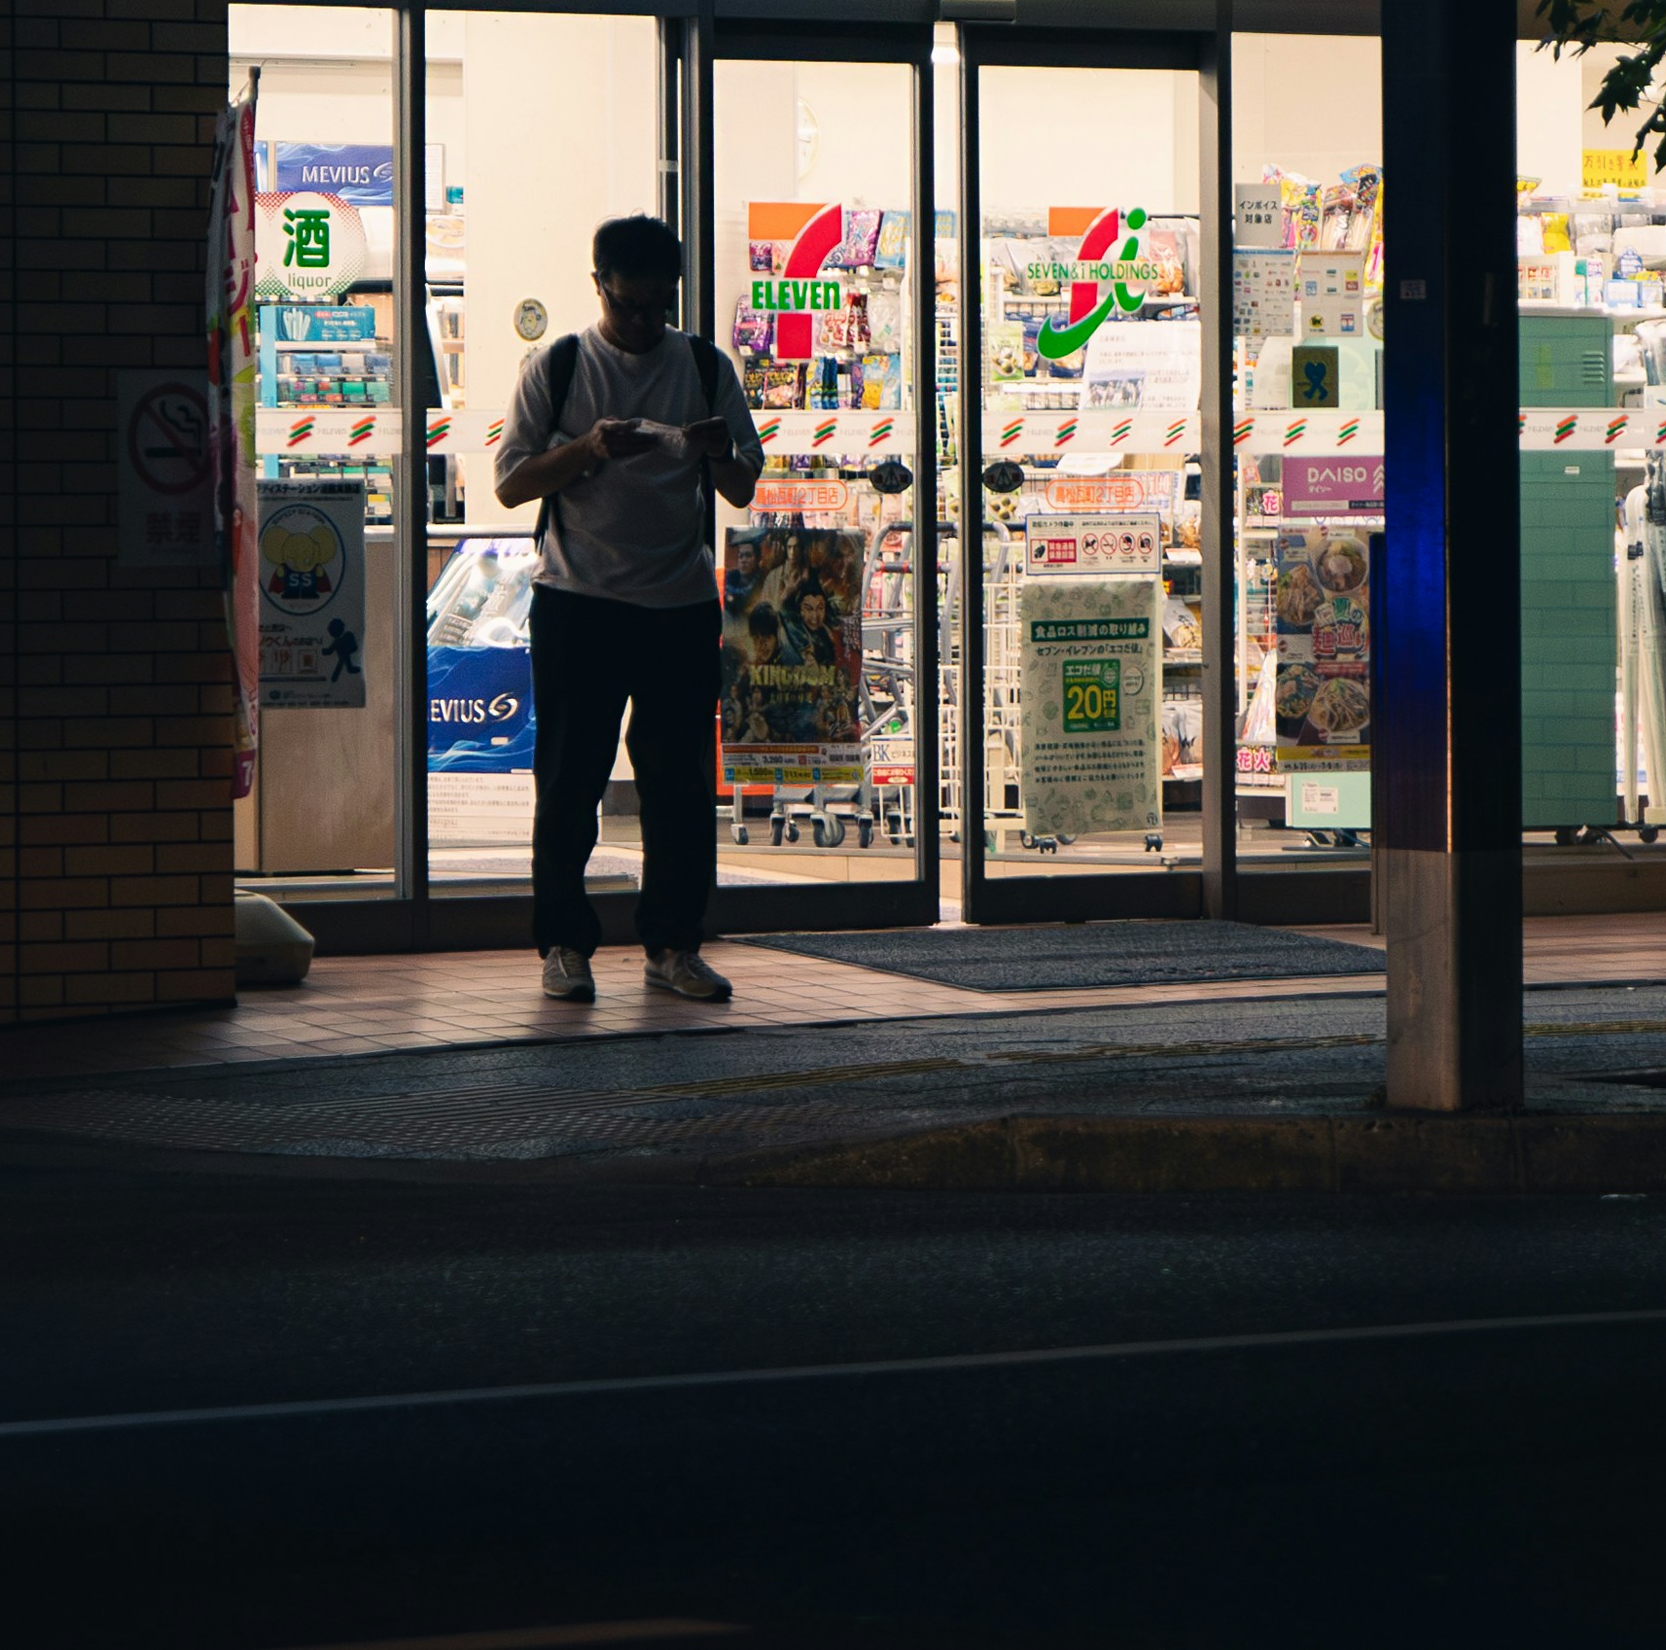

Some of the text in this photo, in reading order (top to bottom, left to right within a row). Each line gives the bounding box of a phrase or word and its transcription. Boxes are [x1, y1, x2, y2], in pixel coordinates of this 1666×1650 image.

[302, 165, 370, 185] MEVIUS
[1239, 200, 1278, 210] インボイス
[1245, 214, 1272, 224] 対象店
[282, 207, 331, 269] 酒
[288, 272, 332, 290] liquor
[1027, 261, 1158, 281] SEVEN&i HOLDINGS
[1307, 467, 1367, 483] DAISO
[1262, 490, 1280, 514] 花
[289, 573, 313, 587] SS
[428, 699, 486, 724] EVIUS
[1237, 749, 1271, 772] 花火
